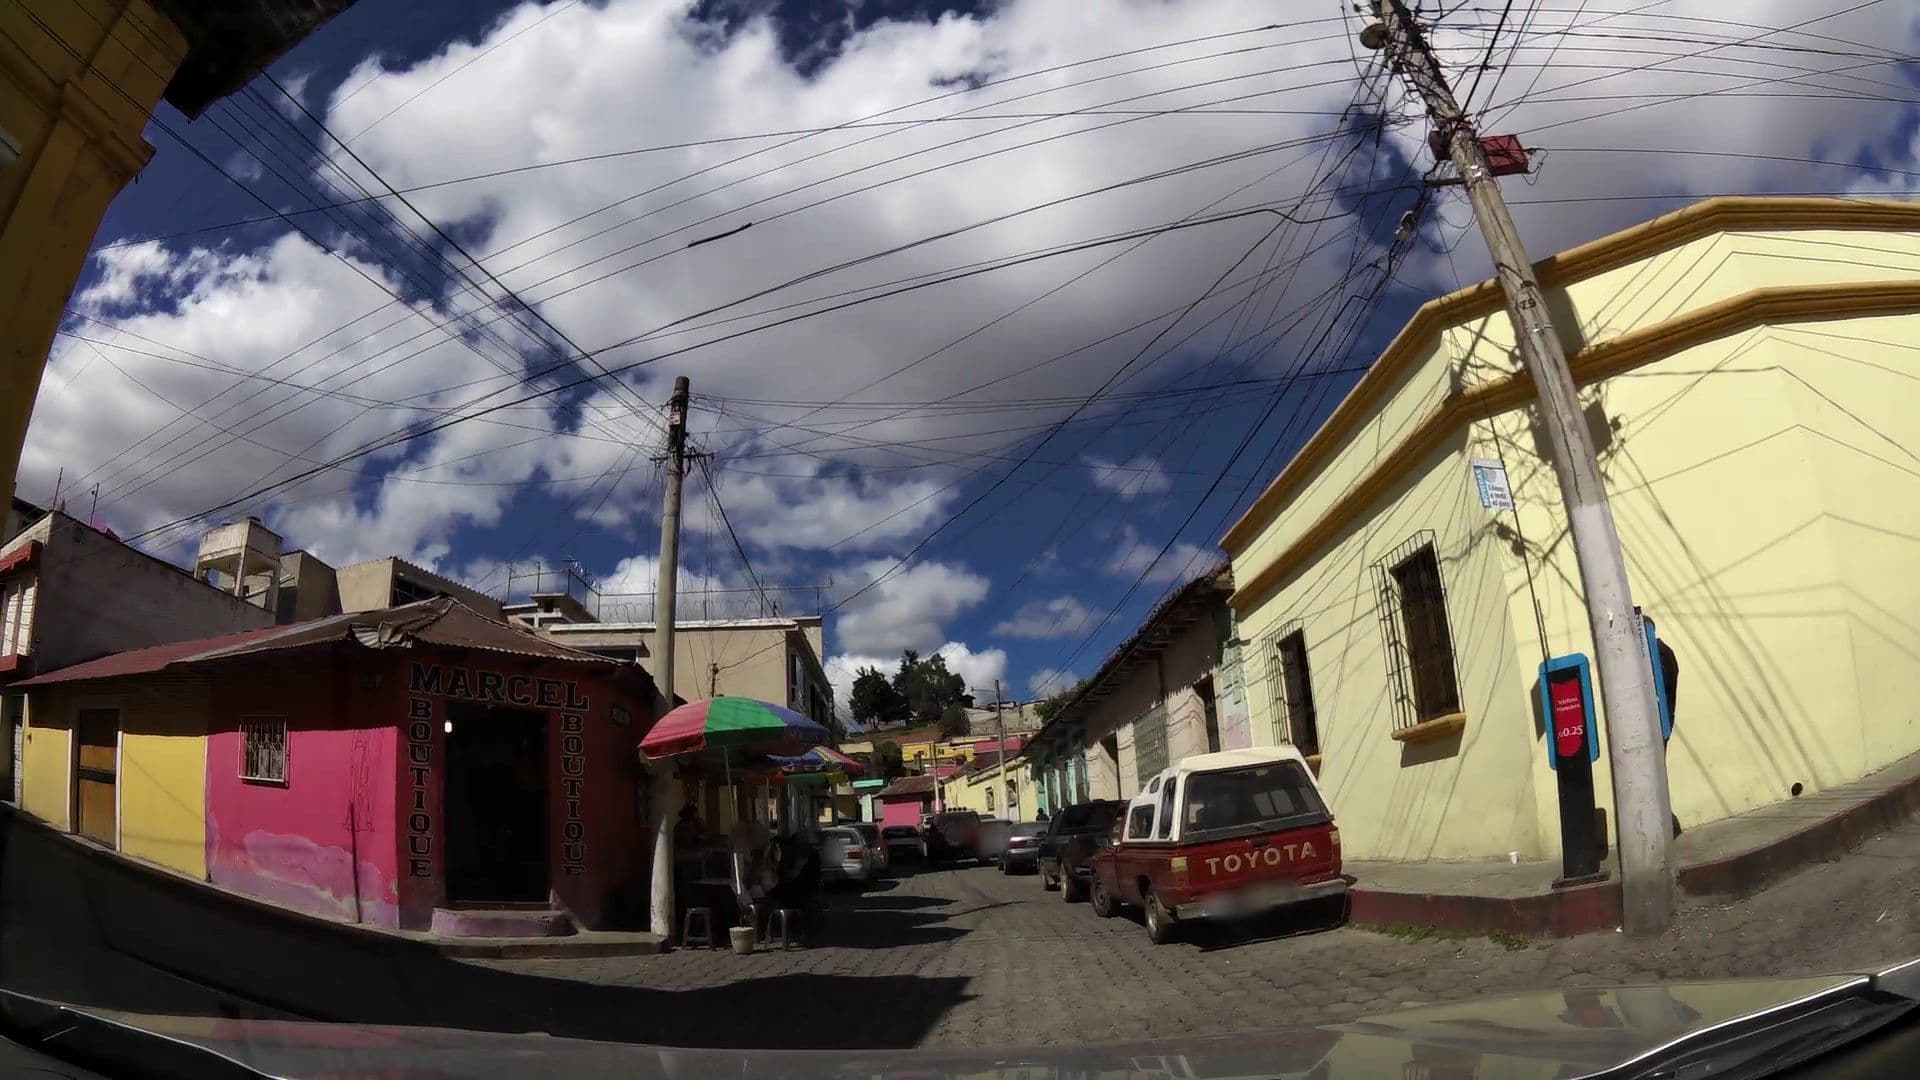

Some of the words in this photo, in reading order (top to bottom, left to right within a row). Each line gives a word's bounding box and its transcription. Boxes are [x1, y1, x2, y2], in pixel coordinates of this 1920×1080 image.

[409, 663, 590, 711] MARCEL
[408, 698, 433, 878] BOUTIQUE
[1205, 841, 1317, 875] TOYOTA
